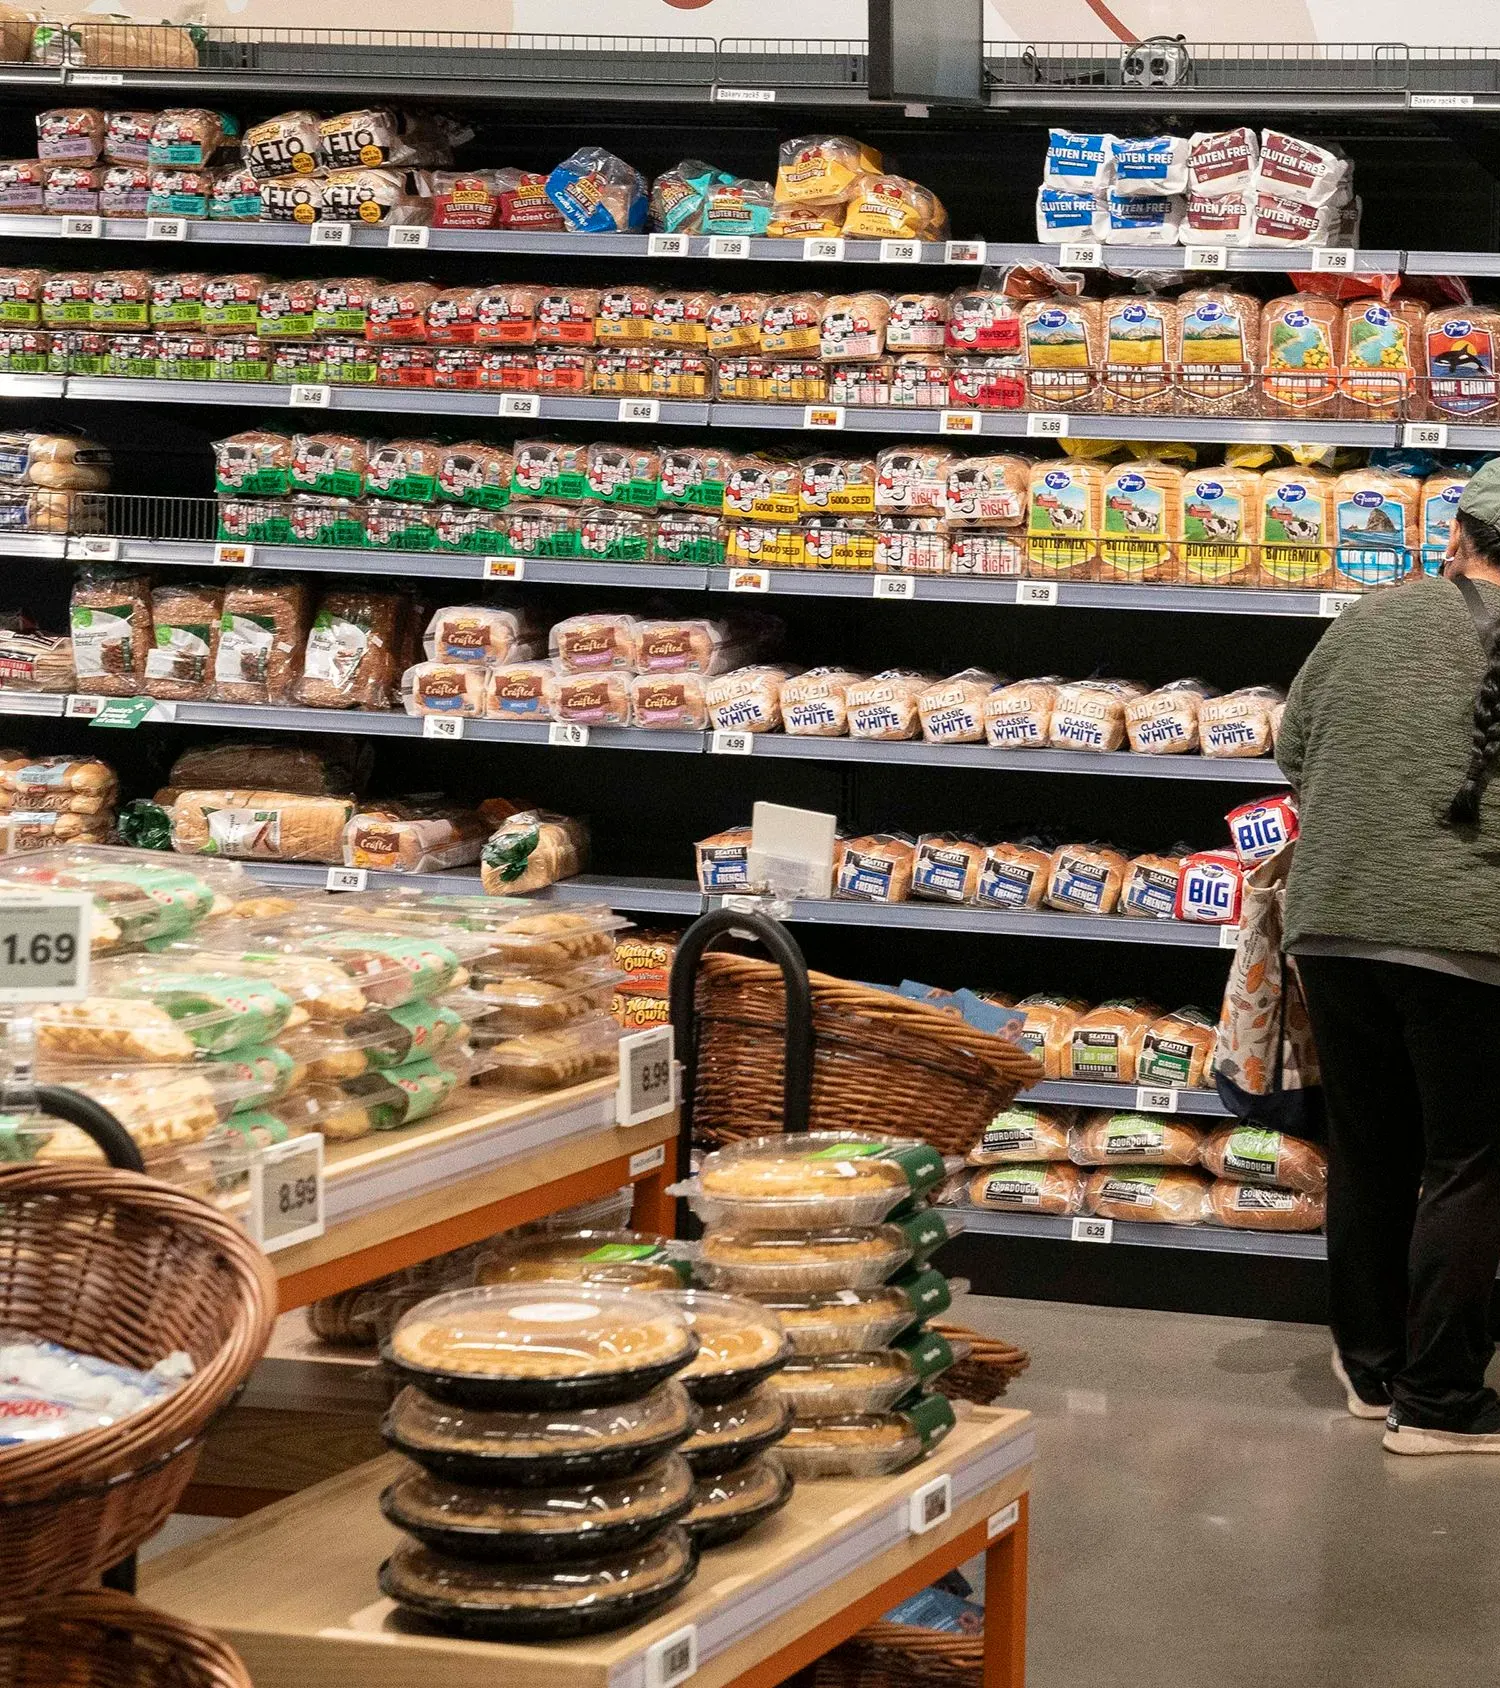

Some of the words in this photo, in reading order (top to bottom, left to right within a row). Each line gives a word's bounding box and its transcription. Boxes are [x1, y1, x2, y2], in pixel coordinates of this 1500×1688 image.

[1047, 148, 1080, 160] GLUTEN
[1081, 150, 1104, 163] FREE
[1148, 153, 1173, 164] FREE
[1188, 150, 1226, 168] GLUTEN
[1260, 148, 1297, 169] GLUTEN
[1298, 158, 1326, 176] FREE
[446, 204, 470, 213] GLUTEN
[471, 205, 495, 214] FREE
[1041, 201, 1072, 211] GLUTEN
[1074, 200, 1096, 211] FREE
[1222, 203, 1246, 215] FREE
[443, 218, 471, 226] Ancient
[510, 214, 542, 222] Ancient
[1256, 207, 1291, 222] GLUTEN
[1292, 214, 1319, 230] FREE
[75, 223, 92, 233] 6.29
[161, 225, 178, 235] 6.29
[325, 231, 342, 239] 6.99
[403, 232, 420, 243] 7.99
[662, 242, 680, 250] 7.99
[723, 244, 741, 252] 7.99
[819, 245, 836, 254] 7.99
[895, 247, 912, 256] 7.99
[1075, 251, 1093, 261] 7.99
[1200, 254, 1219, 263] 7.99
[1328, 256, 1346, 266] 7.99
[513, 401, 531, 411] 6.29
[633, 406, 651, 416] 6.49
[1042, 421, 1060, 431] 5.69
[1420, 432, 1439, 441] 5.69
[830, 495, 849, 505] GOOD
[851, 495, 870, 504] SEED
[911, 490, 939, 505] RIGHT
[754, 503, 772, 513] GOOD
[775, 504, 795, 513] SEED
[981, 503, 1010, 516] RIGHT
[1186, 544, 1240, 558] BUTTERMILK
[1266, 547, 1320, 562] BUTTERMILK
[888, 583, 906, 593] 6.29
[1032, 590, 1049, 599] 5.29
[448, 634, 482, 646] Crafted
[649, 644, 684, 654] Crafted
[502, 686, 535, 697] Crafted
[783, 684, 829, 704] NAKED
[568, 695, 602, 706] Crafted
[719, 699, 752, 714] CLASSIC
[793, 702, 827, 713] CLASSIC
[717, 706, 762, 728] WHITE
[790, 709, 835, 726] WHITE
[1141, 717, 1174, 732] CLASSIC
[1138, 723, 1183, 745] WHITE
[727, 739, 744, 748] 4.99
[1238, 818, 1282, 849] BIG
[1076, 863, 1105, 876] SEATTLE
[341, 874, 358, 887] 4.79
[1189, 878, 1229, 908] BIG
[2, 933, 76, 966] 1.69
[625, 956, 654, 972] Own
[1089, 1033, 1115, 1041] SEATTLE
[1152, 1096, 1170, 1106] 5.29
[991, 1182, 1037, 1194] SOURDOUGH
[1087, 1226, 1105, 1236] 6.29
